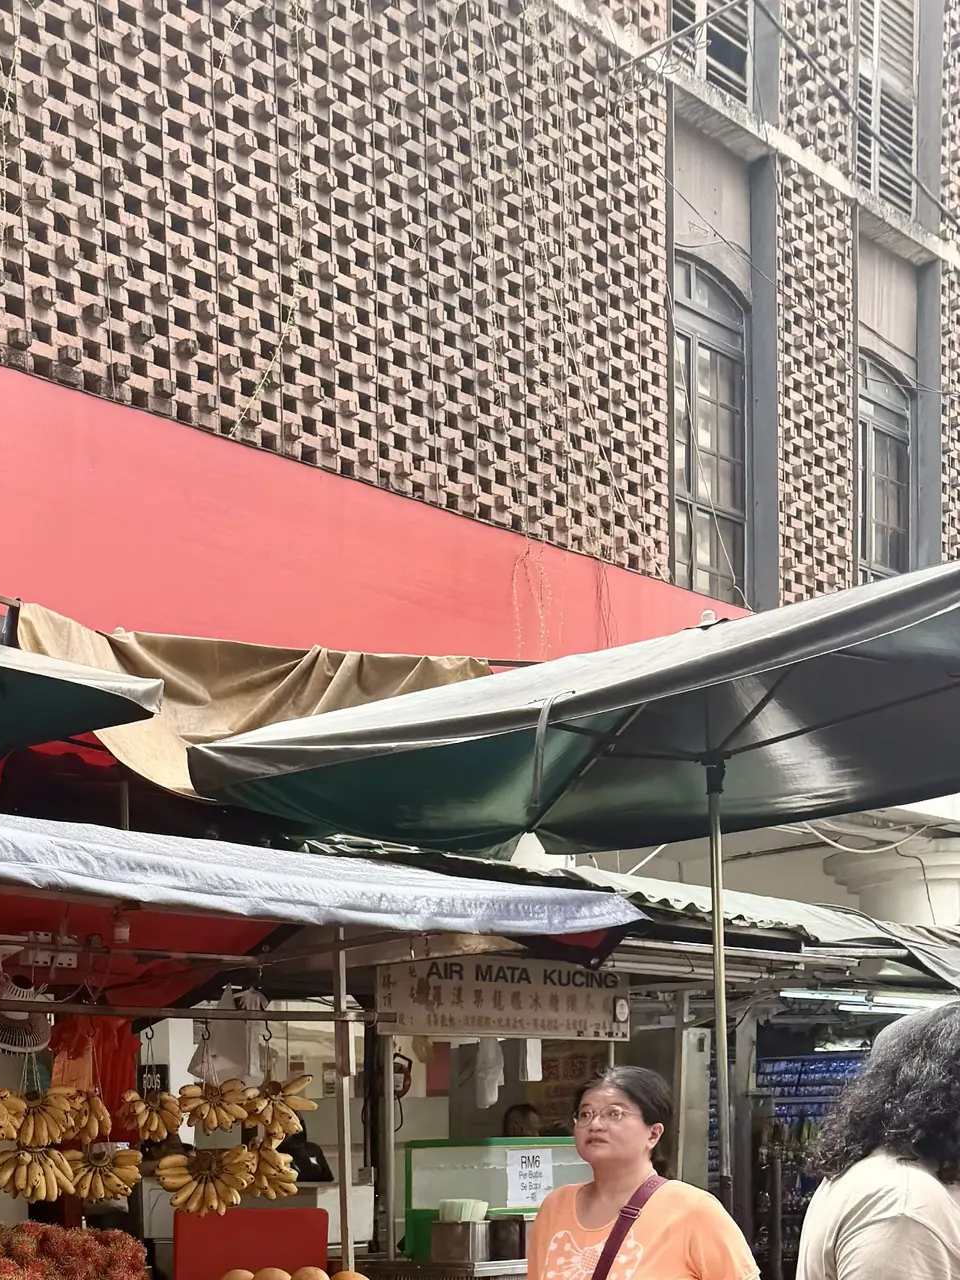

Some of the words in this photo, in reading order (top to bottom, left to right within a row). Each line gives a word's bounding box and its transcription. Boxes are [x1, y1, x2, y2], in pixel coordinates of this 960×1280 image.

[427, 961, 464, 981] AIR
[475, 964, 532, 985] MATA
[543, 968, 618, 988] KUCING
[520, 1155, 541, 1169] RM6
